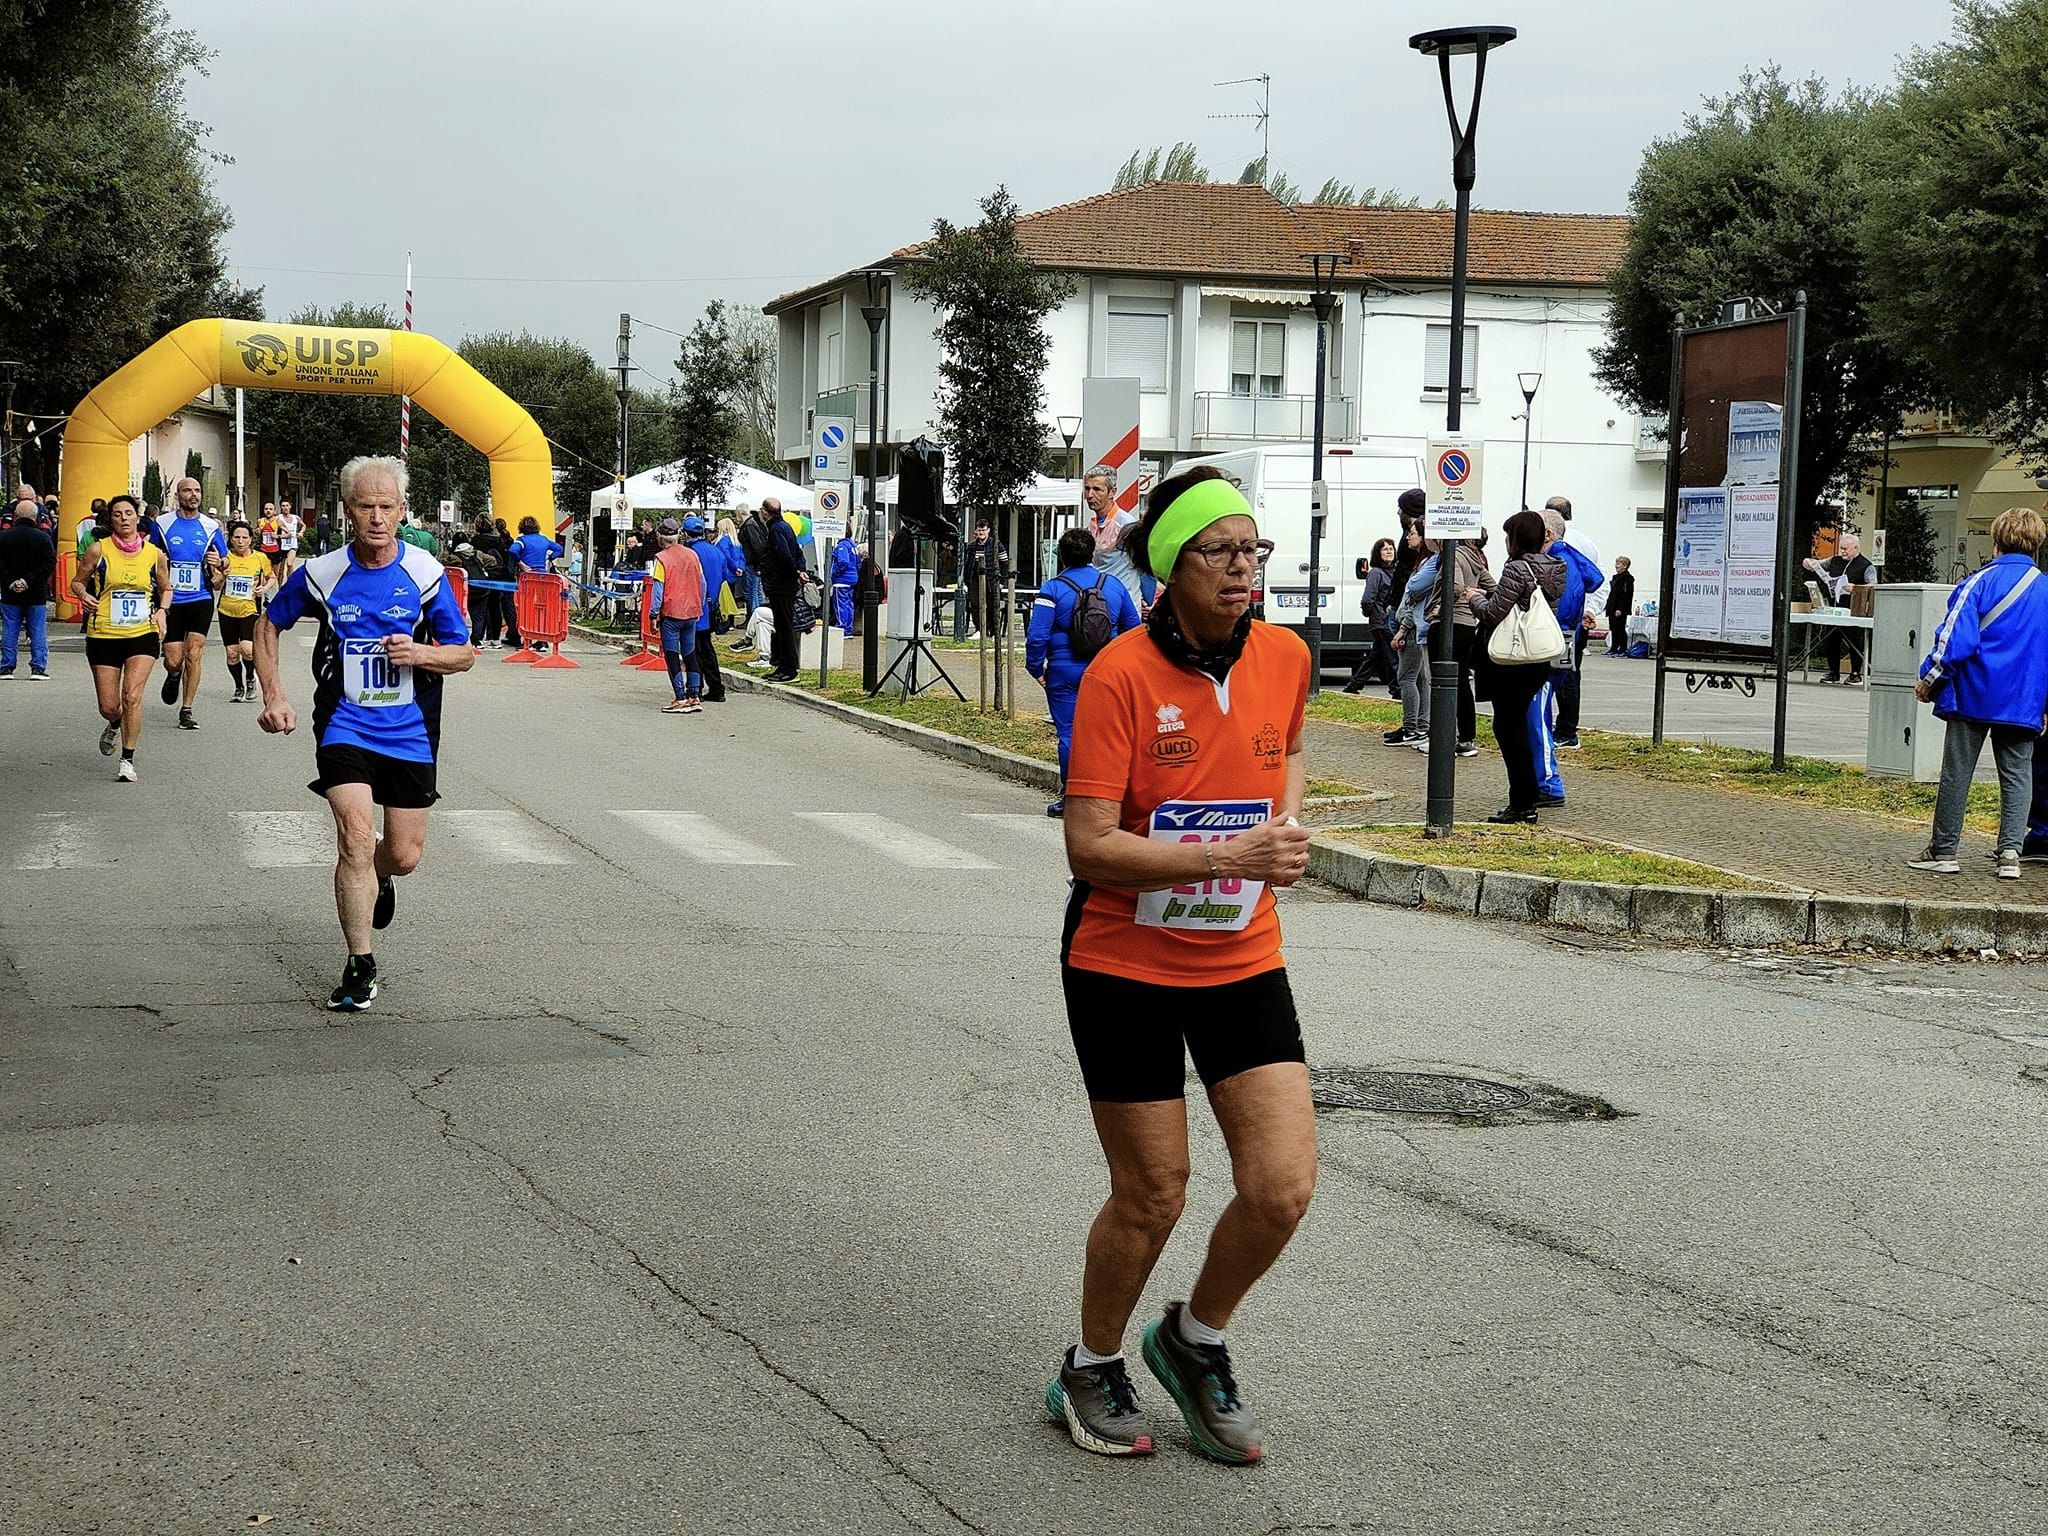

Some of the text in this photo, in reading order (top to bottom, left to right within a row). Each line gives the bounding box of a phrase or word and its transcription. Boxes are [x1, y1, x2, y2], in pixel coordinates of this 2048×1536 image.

[295, 336, 379, 366] UISP
[295, 365, 379, 378] UNIONE ITALIANA
[295, 374, 374, 386] SPORT PER TUTTI
[1731, 431, 1779, 453] Ivan Alvisi
[1734, 511, 1775, 523] NARDI NATALIA
[178, 569, 192, 584] 68
[1681, 569, 1720, 577] RINGRAZIAMENTO
[1731, 569, 1770, 577] RINGRAZIAMENTO
[1679, 583, 1719, 596] ALVISI IVAN
[1728, 587, 1771, 597] TURCHI ANSELMO
[122, 599, 138, 617] 92
[360, 657, 401, 689] 108
[1157, 740, 1192, 755] LUCCI
